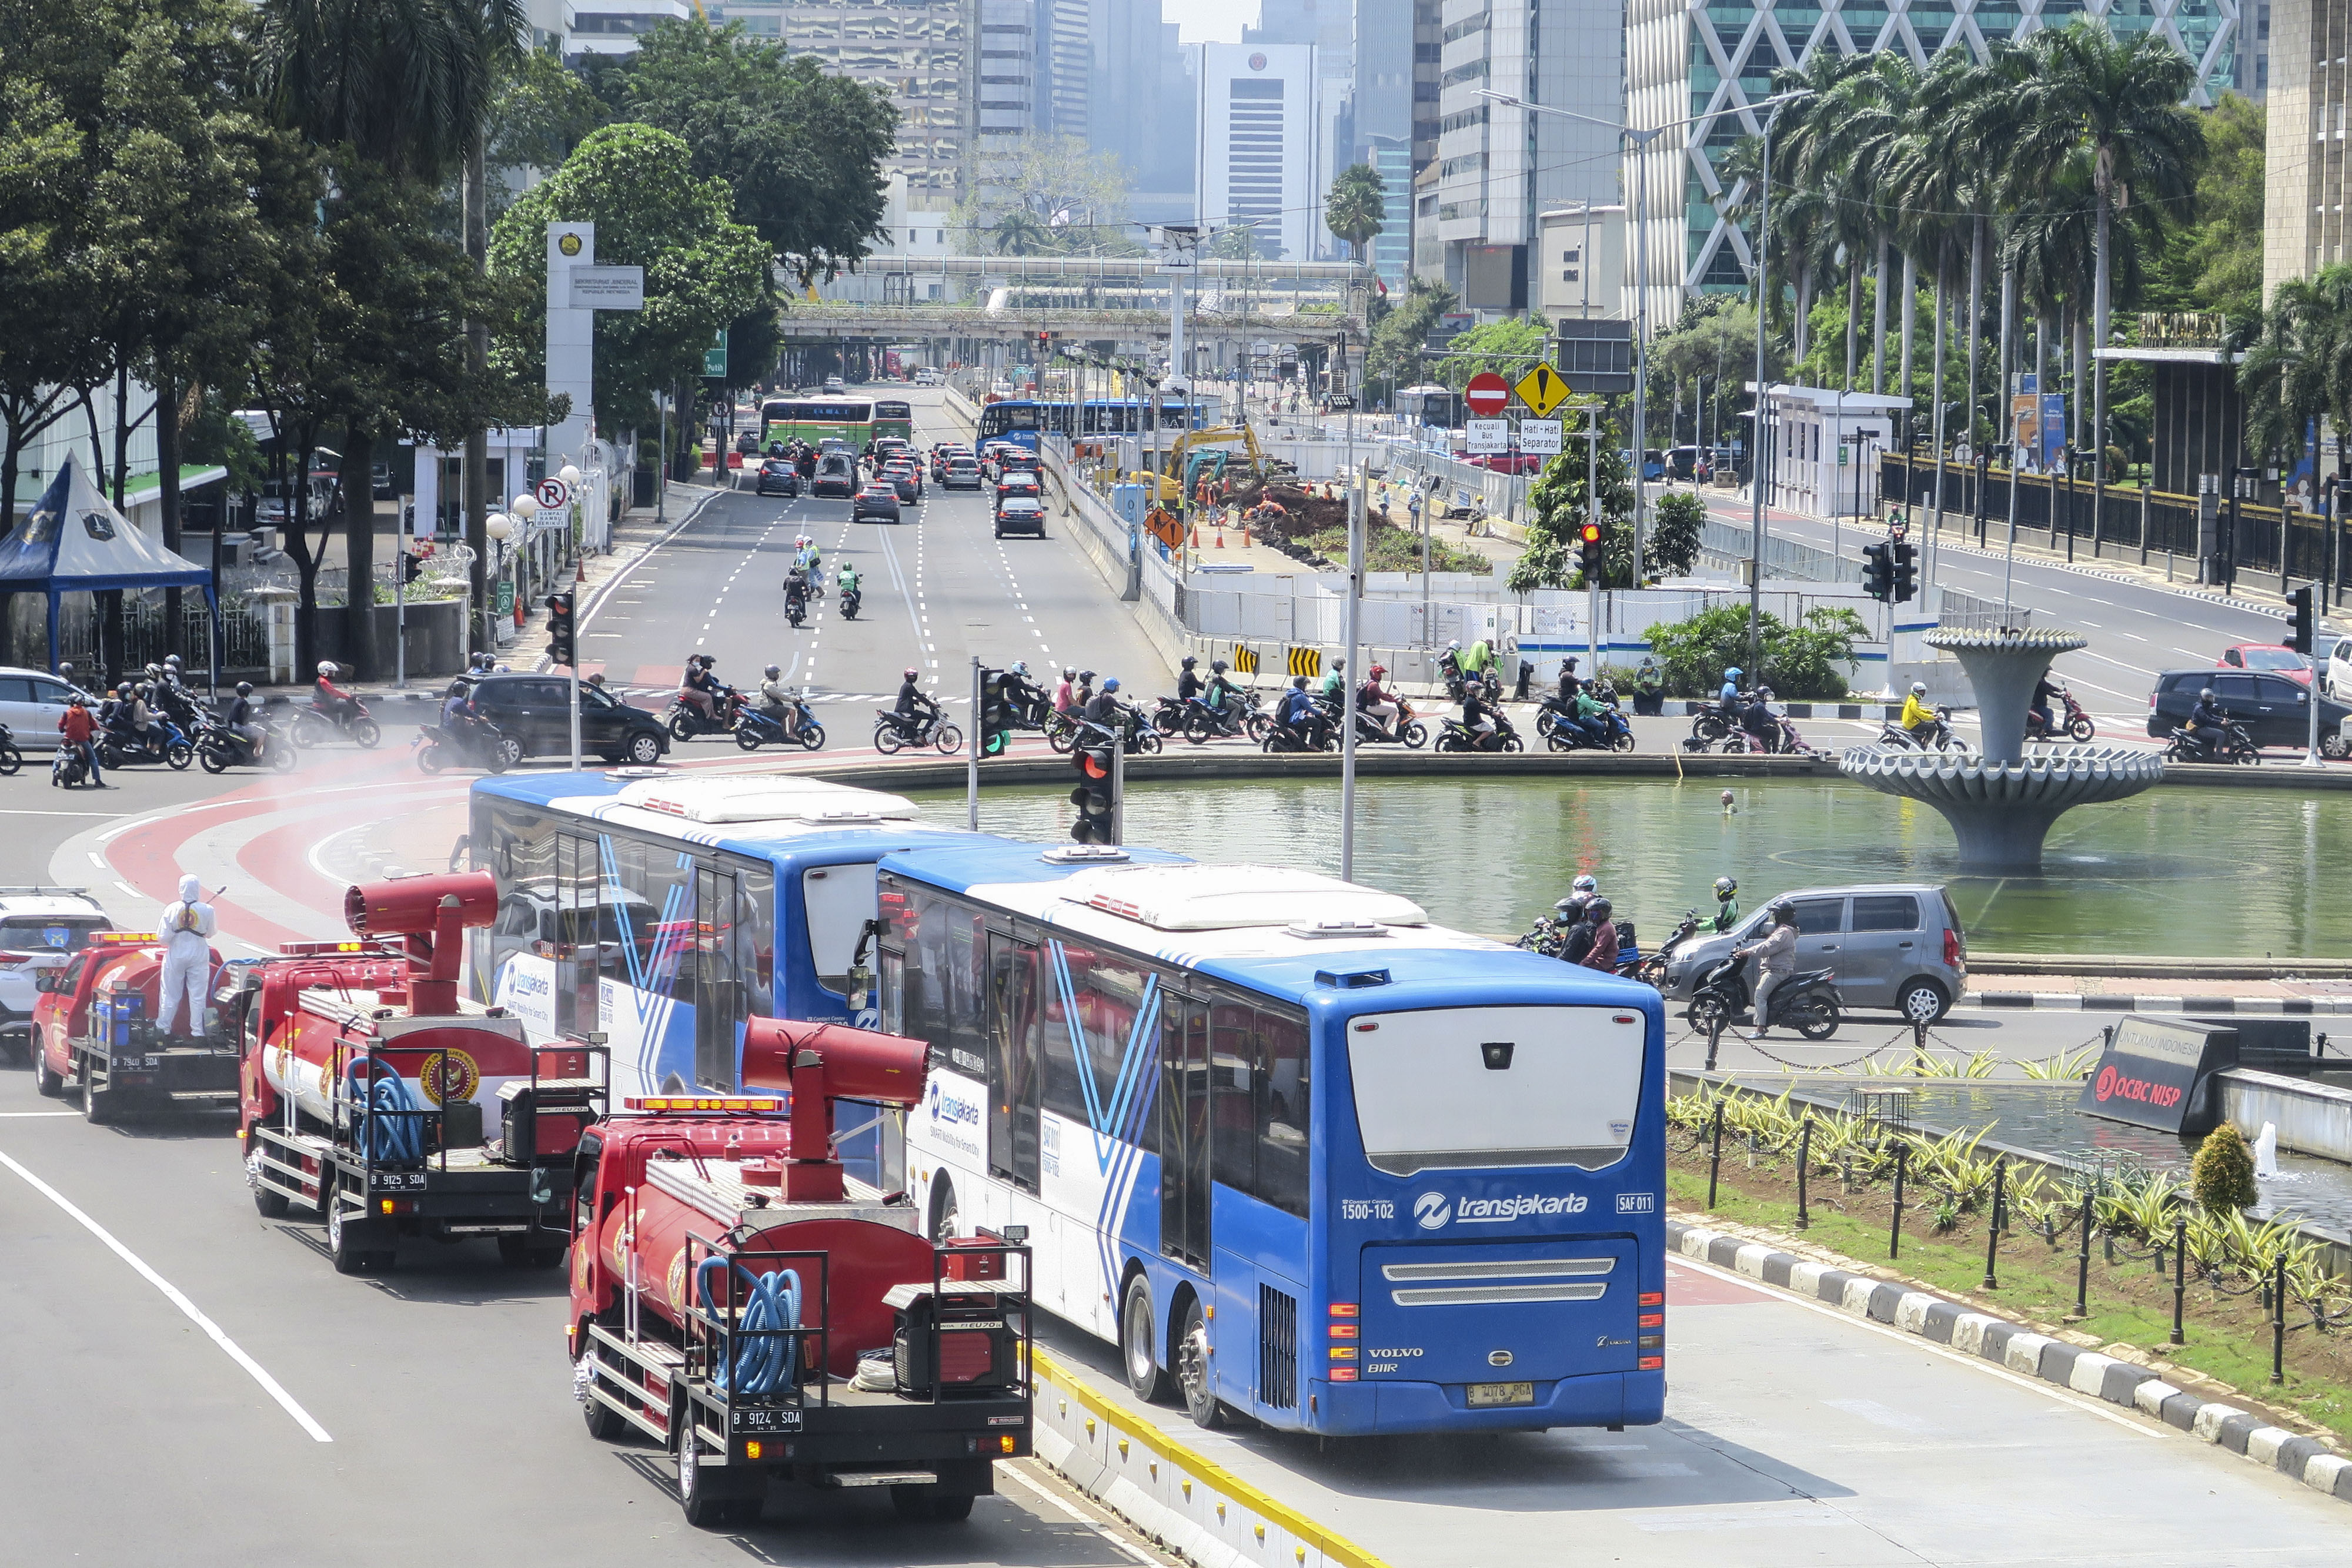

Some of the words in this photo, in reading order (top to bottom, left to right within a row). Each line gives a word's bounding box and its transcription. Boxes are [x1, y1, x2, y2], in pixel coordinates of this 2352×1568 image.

[707, 363, 724, 372] Putih
[1475, 422, 1499, 430] Kecuali
[1524, 424, 1539, 434] Hati
[1544, 424, 1559, 434] Hati
[1468, 441, 1507, 450] Transjakarta
[1522, 438, 1559, 449] Separator
[516, 969, 549, 997] transjakarta
[507, 998, 517, 1010] SMART
[517, 1002, 528, 1017] Mobility
[533, 1007, 542, 1020] Smart
[2119, 1031, 2157, 1048] UNTUKMU
[2157, 1038, 2200, 1057] INDONESIA
[112, 1058, 117, 1066] B
[123, 1058, 139, 1066] 7940
[145, 1057, 158, 1066] SDA
[2115, 1077, 2151, 1102] OCBC
[2149, 1084, 2181, 1107] NISP
[941, 1091, 979, 1126] transjakarta
[930, 1125, 942, 1141] SMART
[942, 1130, 956, 1149] Mobility
[961, 1138, 971, 1154] Smart
[1043, 1158, 1060, 1178] 1500-102
[371, 1175, 376, 1185] B
[383, 1175, 402, 1185] 9125
[409, 1175, 425, 1184] SDA
[1455, 1192, 1589, 1223] transjakarta
[1619, 1196, 1635, 1211] SAF
[1636, 1196, 1652, 1211] 011
[1342, 1203, 1394, 1219] 1500-102
[1368, 1348, 1424, 1358] VOLVO
[1368, 1363, 1398, 1373] B11R
[1469, 1386, 1475, 1398] B
[1481, 1385, 1505, 1398] 7078
[1514, 1384, 1531, 1396] PGA
[733, 1413, 740, 1425] B
[749, 1412, 771, 1425] 9124
[781, 1412, 800, 1424] SDA
